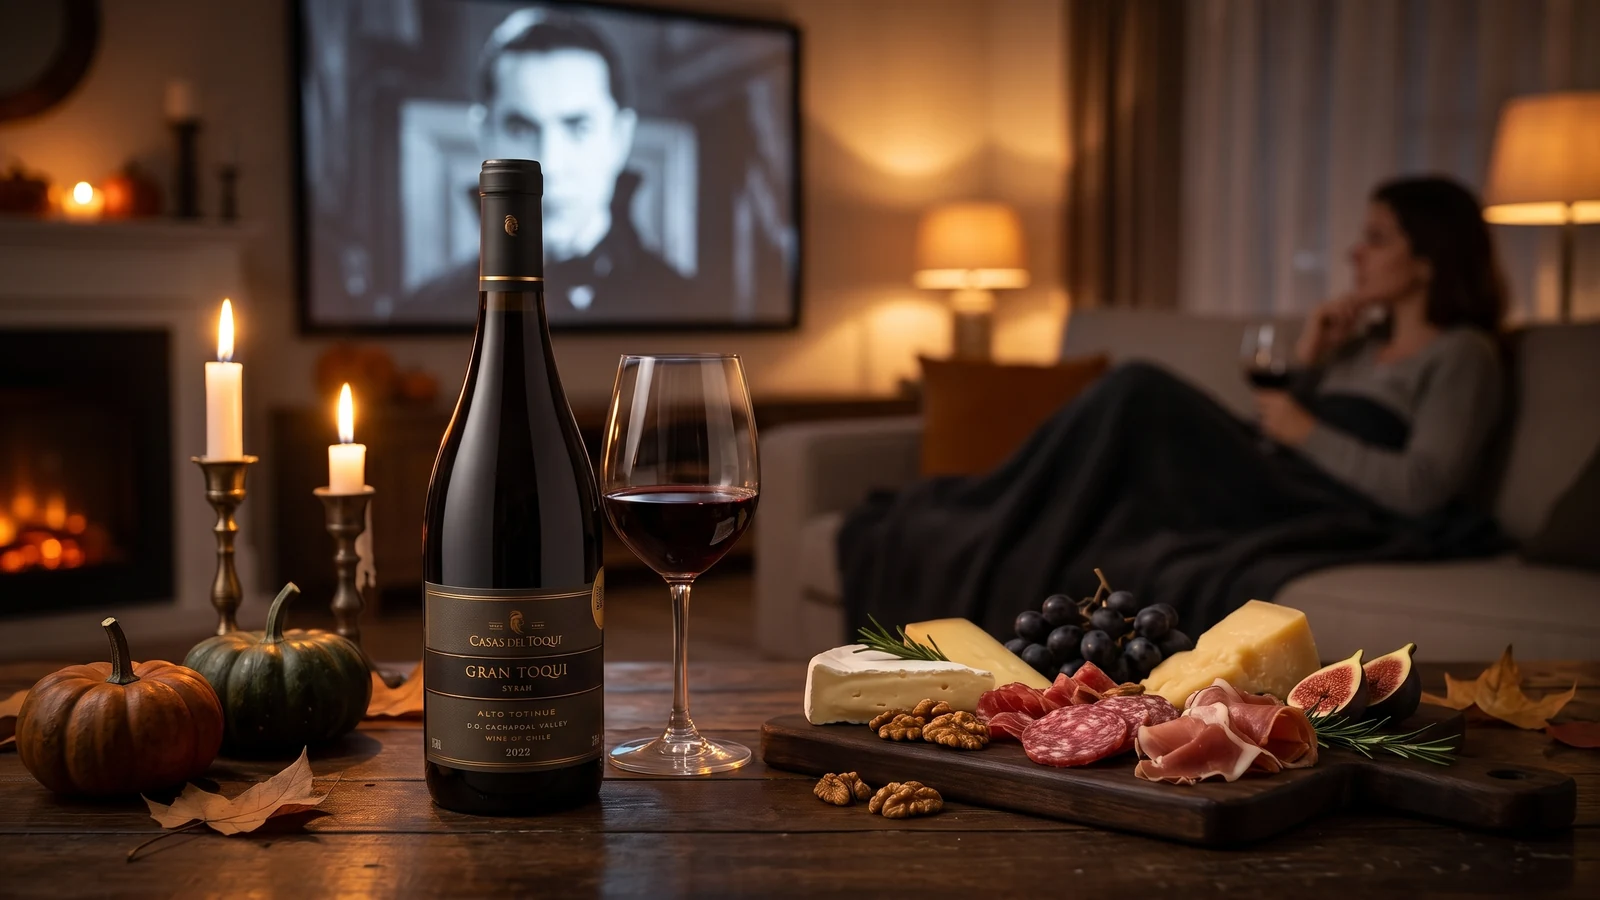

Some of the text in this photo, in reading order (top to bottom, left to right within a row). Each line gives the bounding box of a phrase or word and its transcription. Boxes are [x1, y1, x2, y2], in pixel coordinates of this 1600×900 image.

[469, 635, 562, 647] CASAS DEL TOQUI
[465, 663, 567, 679] GRAN TOQUI
[477, 709, 556, 718] ALTO TOTINUE
[539, 720, 568, 728] VALLEY
[506, 748, 530, 756] 2022
